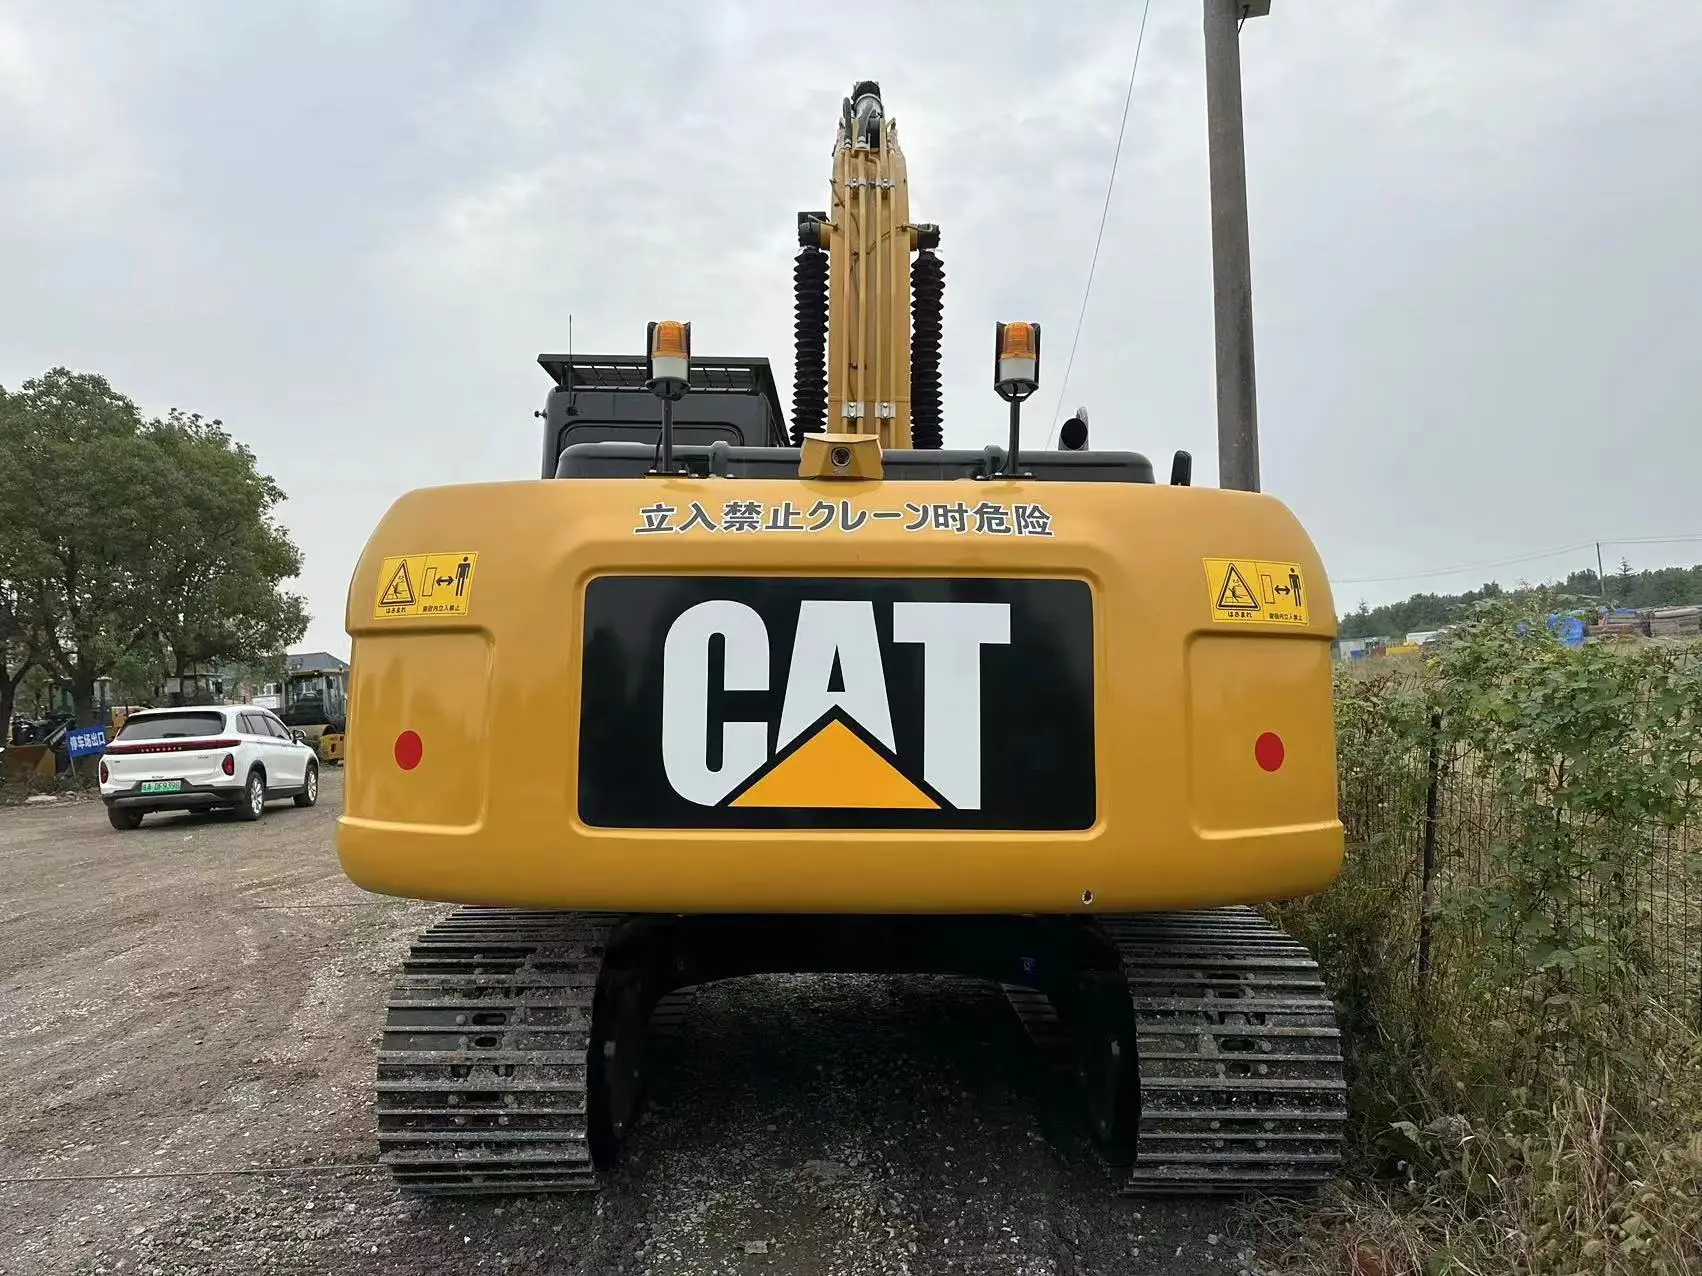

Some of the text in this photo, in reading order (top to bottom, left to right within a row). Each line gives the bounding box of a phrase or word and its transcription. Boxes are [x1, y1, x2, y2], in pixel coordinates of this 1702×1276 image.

[70, 731, 106, 751] 停车场出口
[662, 600, 1011, 810] CAT
